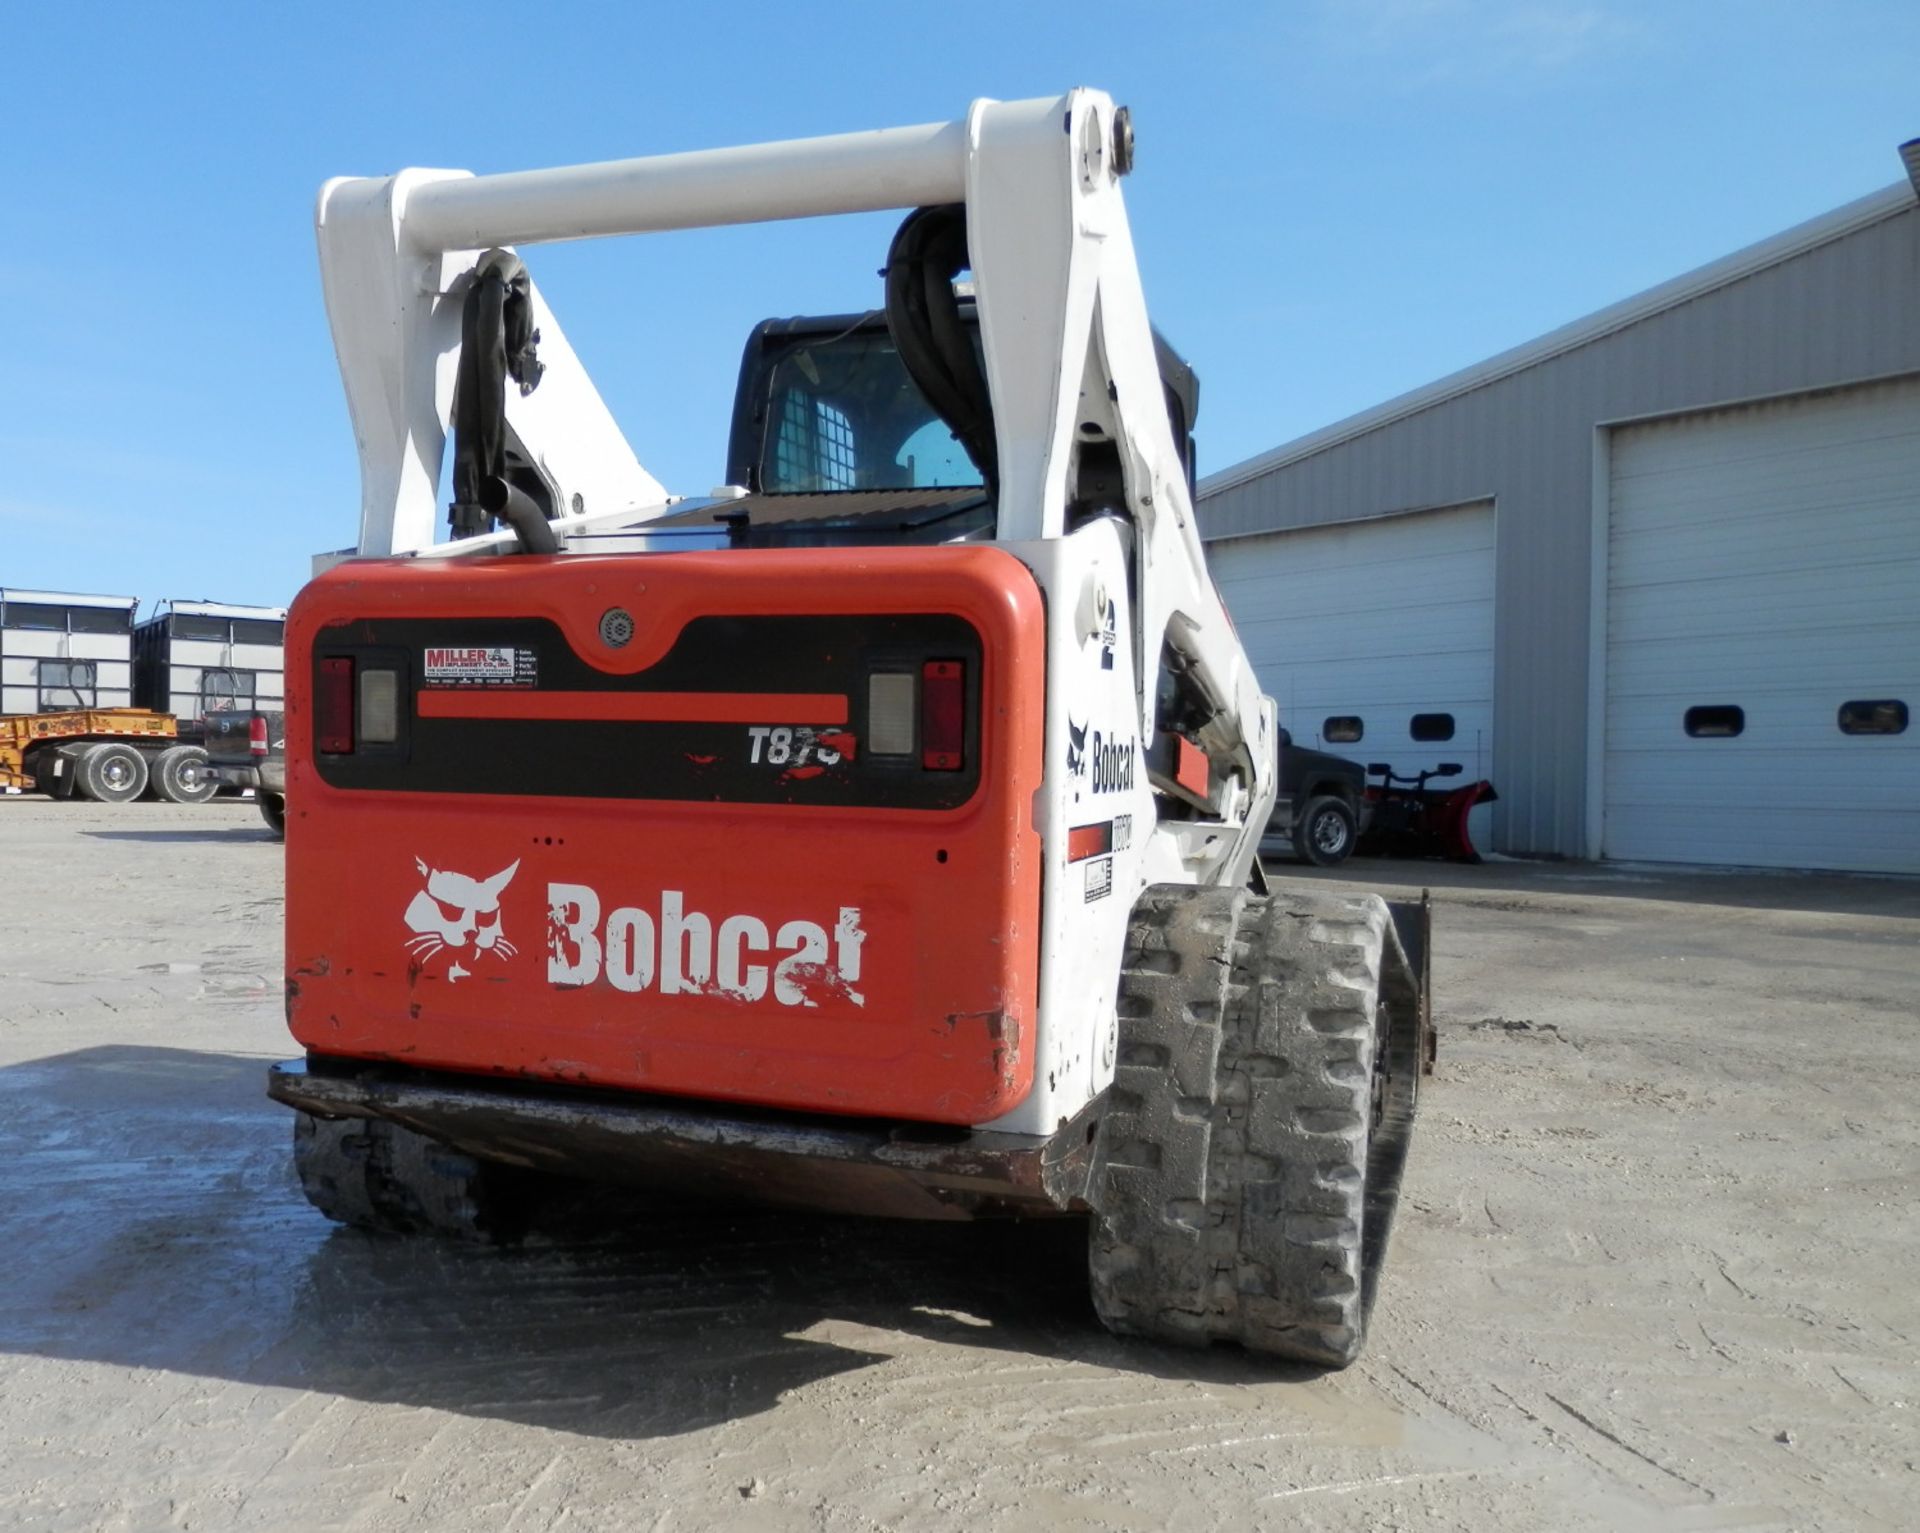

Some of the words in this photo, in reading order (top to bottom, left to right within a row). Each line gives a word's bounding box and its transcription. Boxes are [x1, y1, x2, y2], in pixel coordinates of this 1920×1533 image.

[427, 650, 487, 667] MILLER
[1092, 730, 1136, 794] Bobcat
[547, 882, 866, 1008] Bobcat
